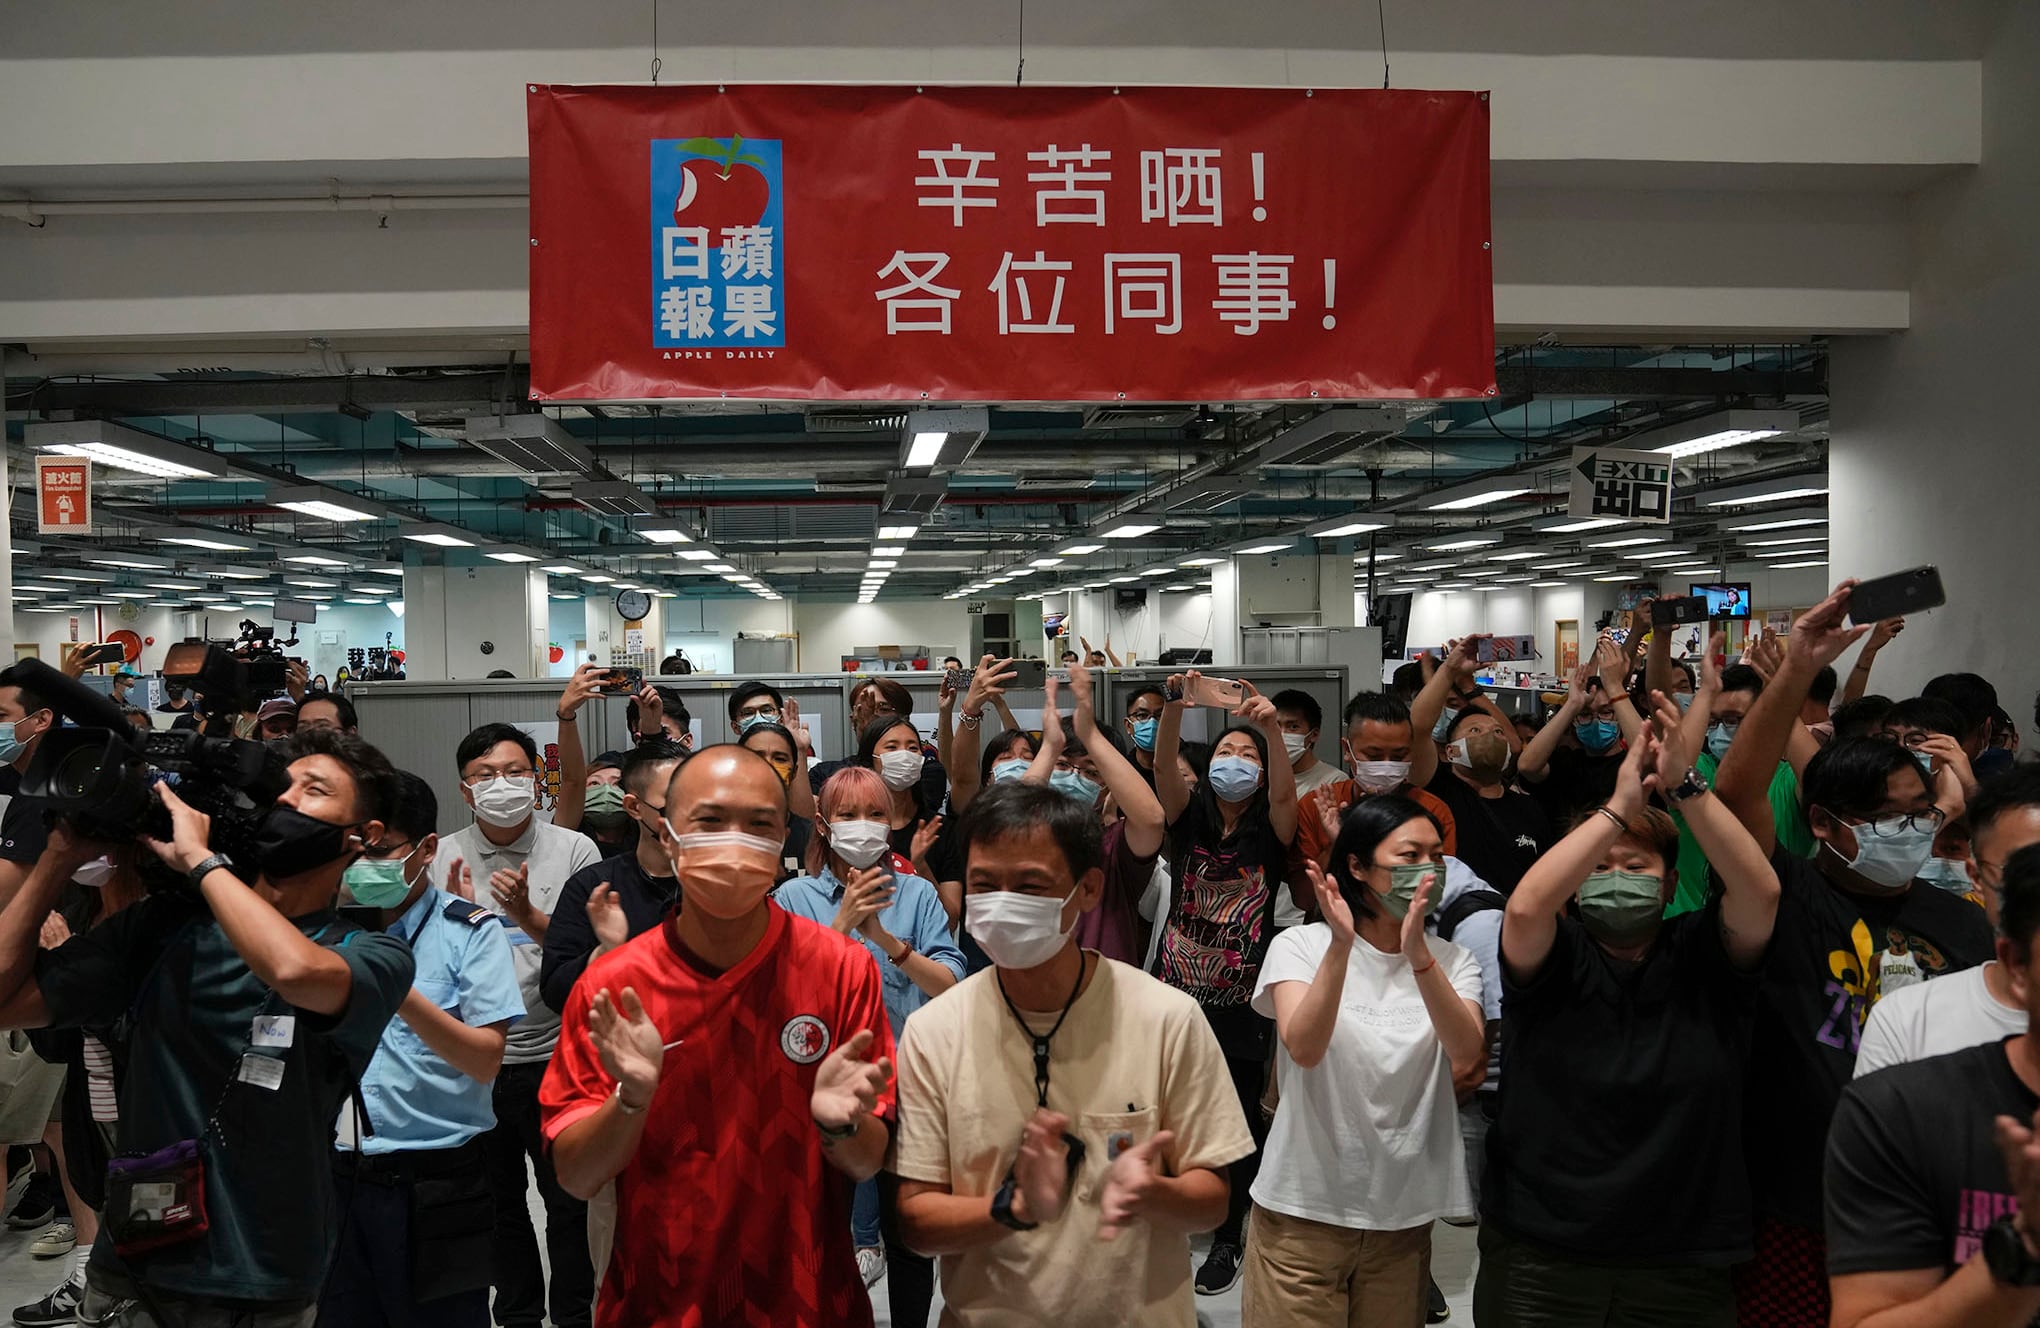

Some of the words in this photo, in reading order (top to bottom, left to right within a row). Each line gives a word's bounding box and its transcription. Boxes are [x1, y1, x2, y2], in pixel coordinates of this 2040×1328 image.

[915, 143, 1267, 227] 辛苦晒！
[875, 251, 1336, 335] 各位同事！
[663, 351, 712, 360] APPLE
[726, 351, 775, 359] DAILY
[1595, 461, 1668, 481] EXIT
[1592, 479, 1667, 519] 出口
[1883, 964, 1916, 977] PELICANS
